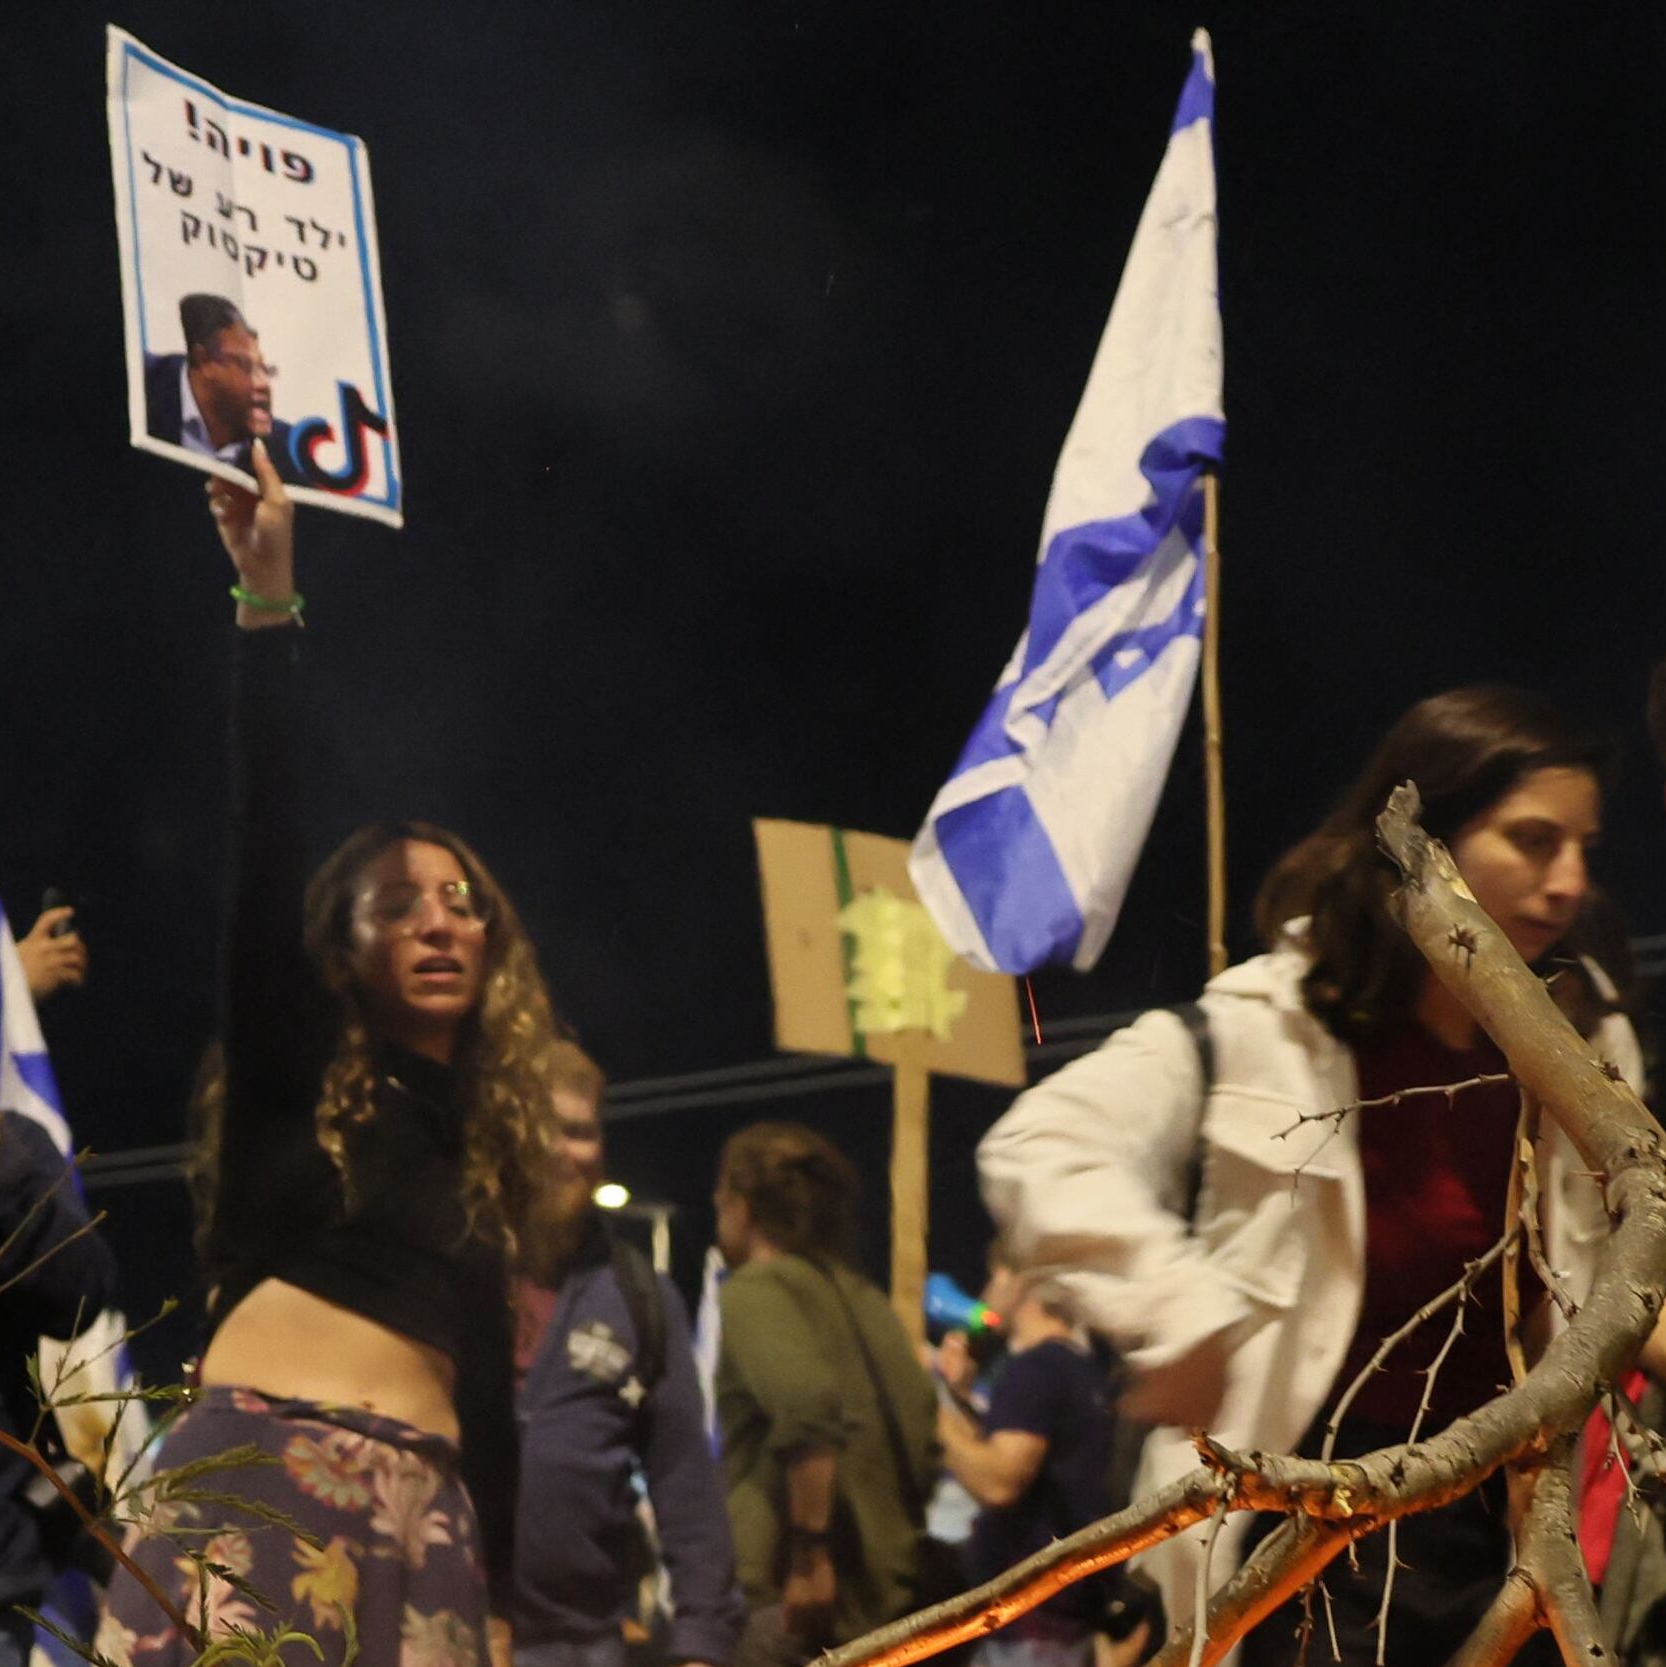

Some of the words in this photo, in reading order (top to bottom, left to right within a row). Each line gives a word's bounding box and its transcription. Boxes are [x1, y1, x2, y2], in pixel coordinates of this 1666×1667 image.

[183, 98, 316, 184] פויה!
[141, 150, 193, 197] של
[216, 192, 260, 232] רע
[284, 212, 347, 251] ילד
[180, 208, 320, 283] טיקטוק
